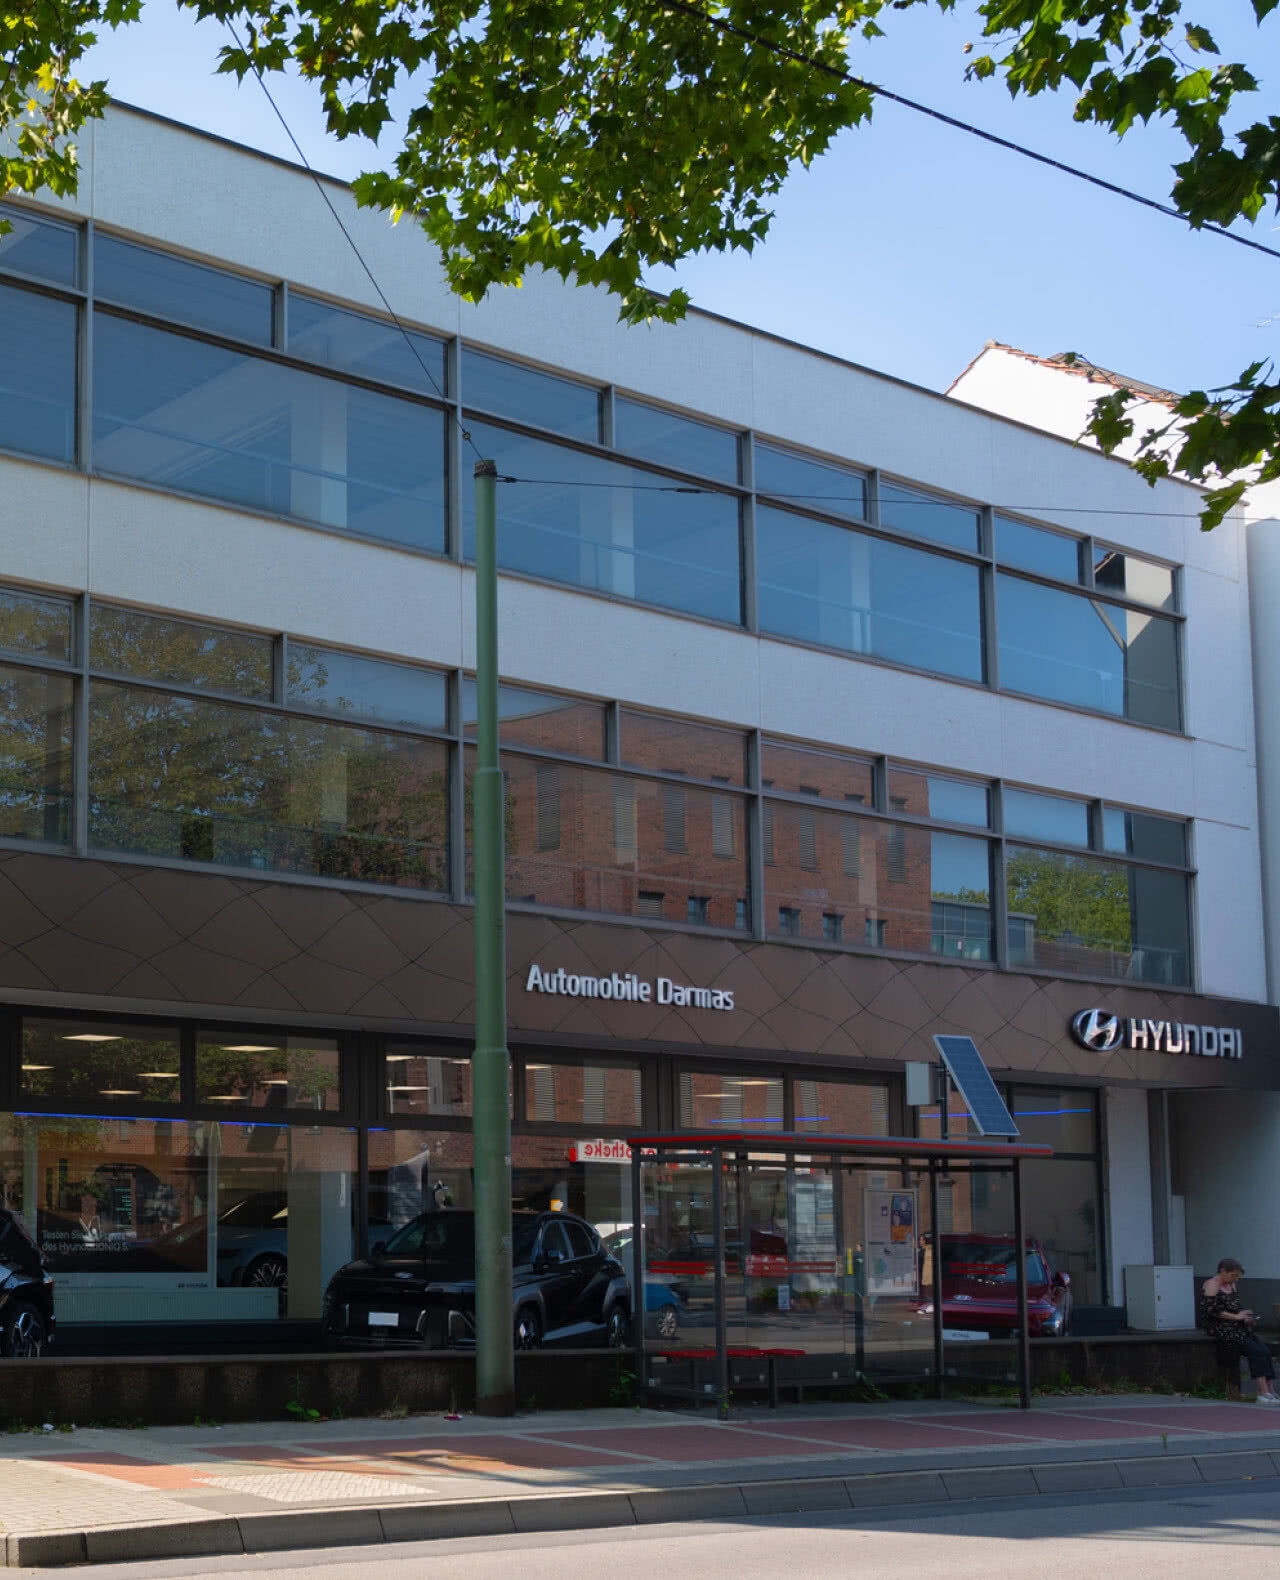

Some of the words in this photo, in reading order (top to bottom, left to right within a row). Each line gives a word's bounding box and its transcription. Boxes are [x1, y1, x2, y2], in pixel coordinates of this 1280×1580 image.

[526, 963, 651, 1002] Automobile
[656, 977, 735, 1010] Darmas
[1130, 1018, 1243, 1059] HYUNDAI
